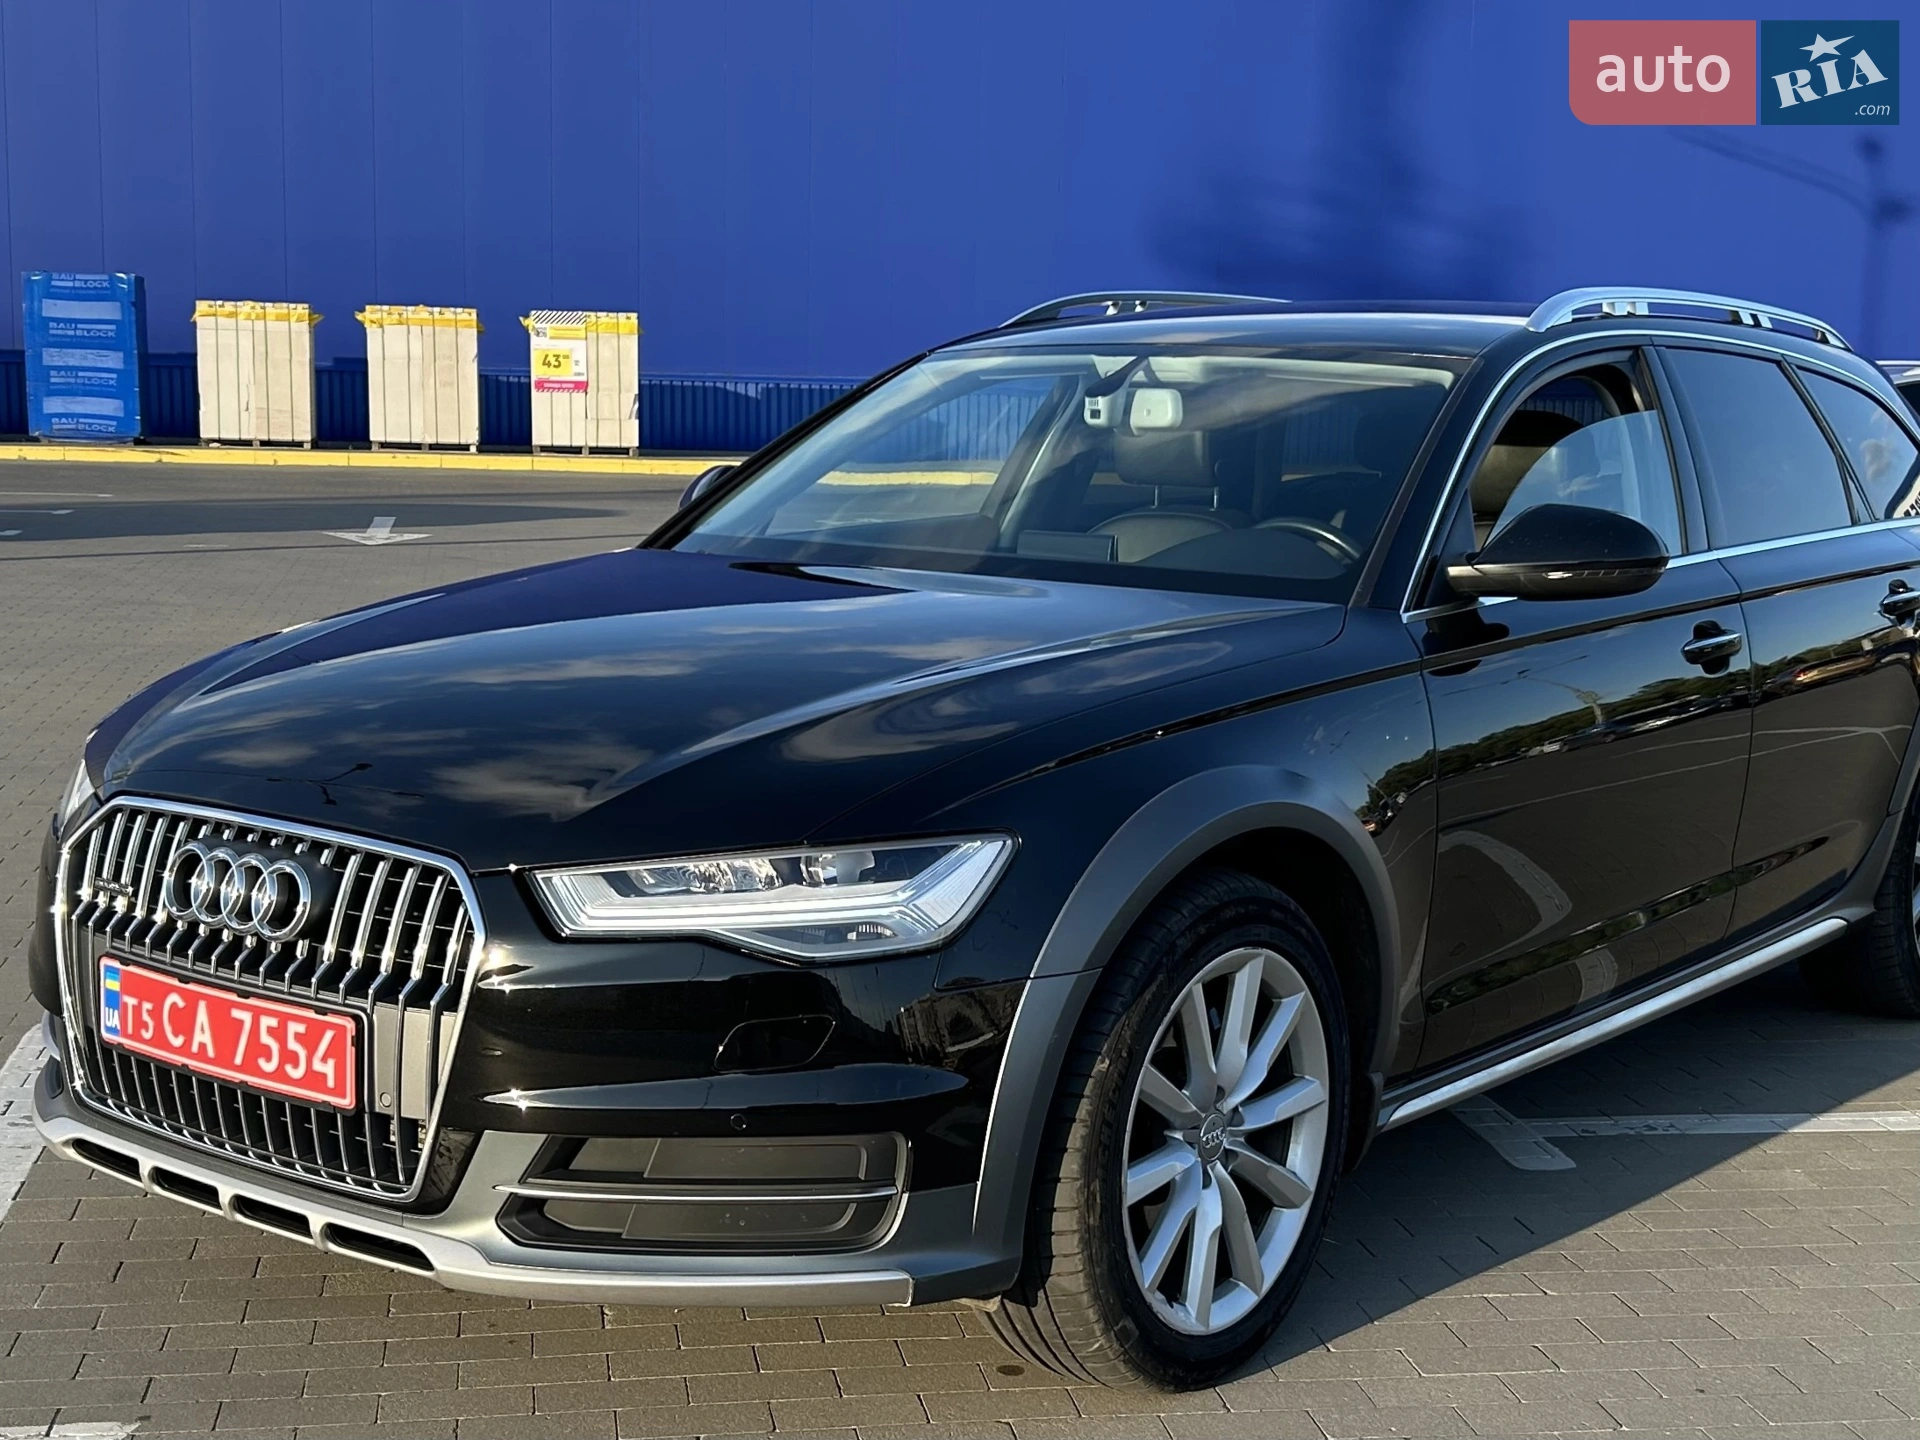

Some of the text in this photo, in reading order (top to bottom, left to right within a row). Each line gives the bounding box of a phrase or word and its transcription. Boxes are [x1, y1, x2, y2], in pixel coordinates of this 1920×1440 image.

[52, 273, 75, 281] BAU
[74, 280, 110, 288] BLOCK
[49, 322, 76, 330] BAU
[75, 329, 116, 338] BLOCK
[50, 370, 77, 378] BAU
[76, 377, 117, 386] BLOCK
[51, 417, 78, 425] BAU
[78, 424, 116, 432] BLOCK
[105, 1006, 121, 1030] UA
[230, 1007, 337, 1089] 7554
